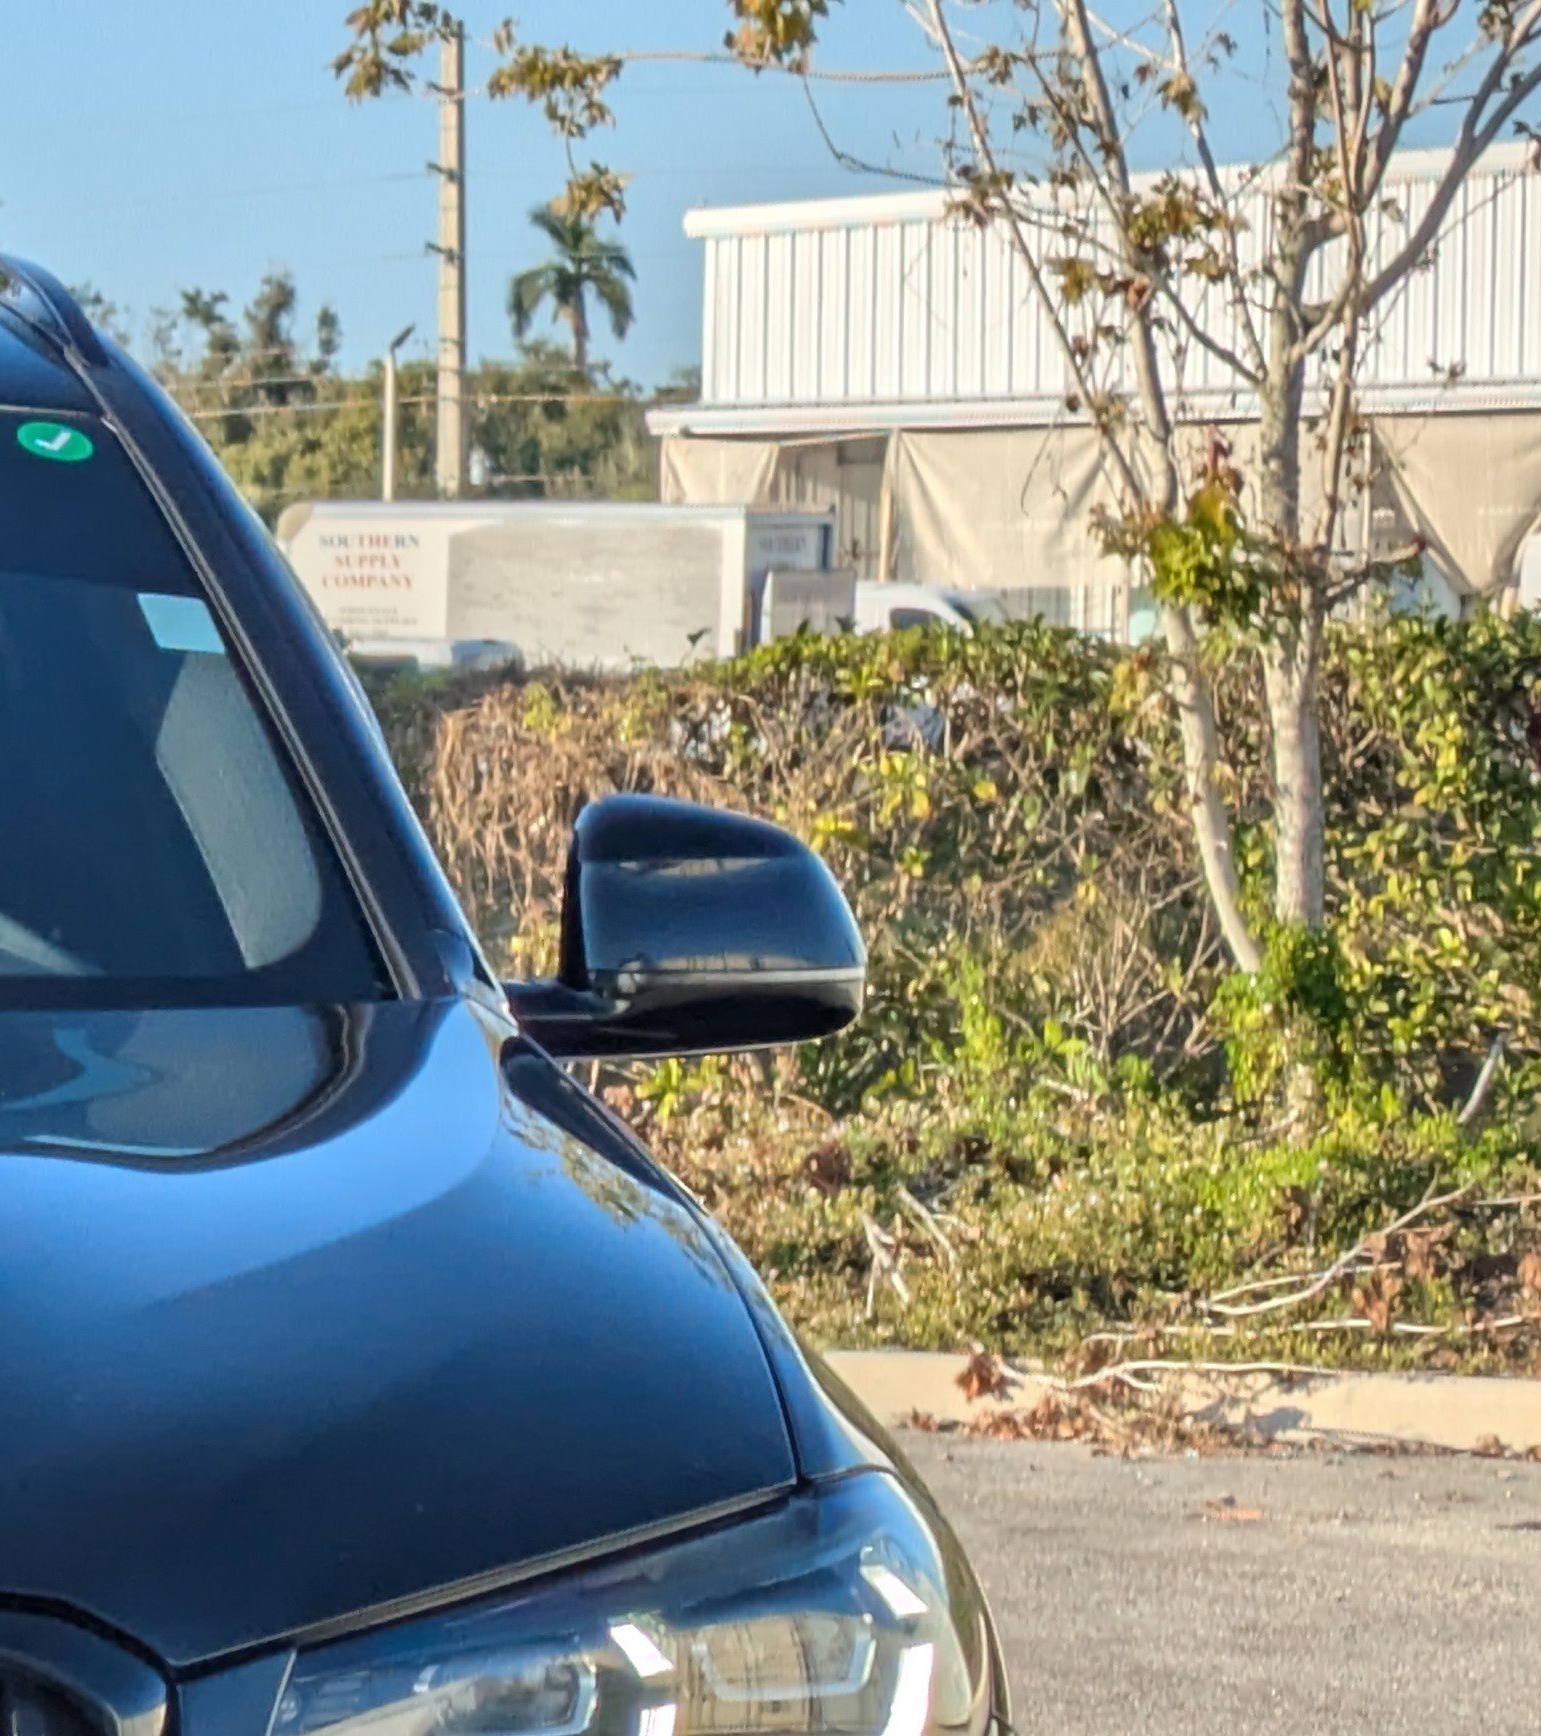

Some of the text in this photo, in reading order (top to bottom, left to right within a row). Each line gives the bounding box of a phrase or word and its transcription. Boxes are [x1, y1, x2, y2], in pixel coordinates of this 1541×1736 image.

[319, 534, 419, 549] SOUTHERN
[334, 554, 401, 569] SUPPLY
[321, 574, 414, 590] COMPANY
